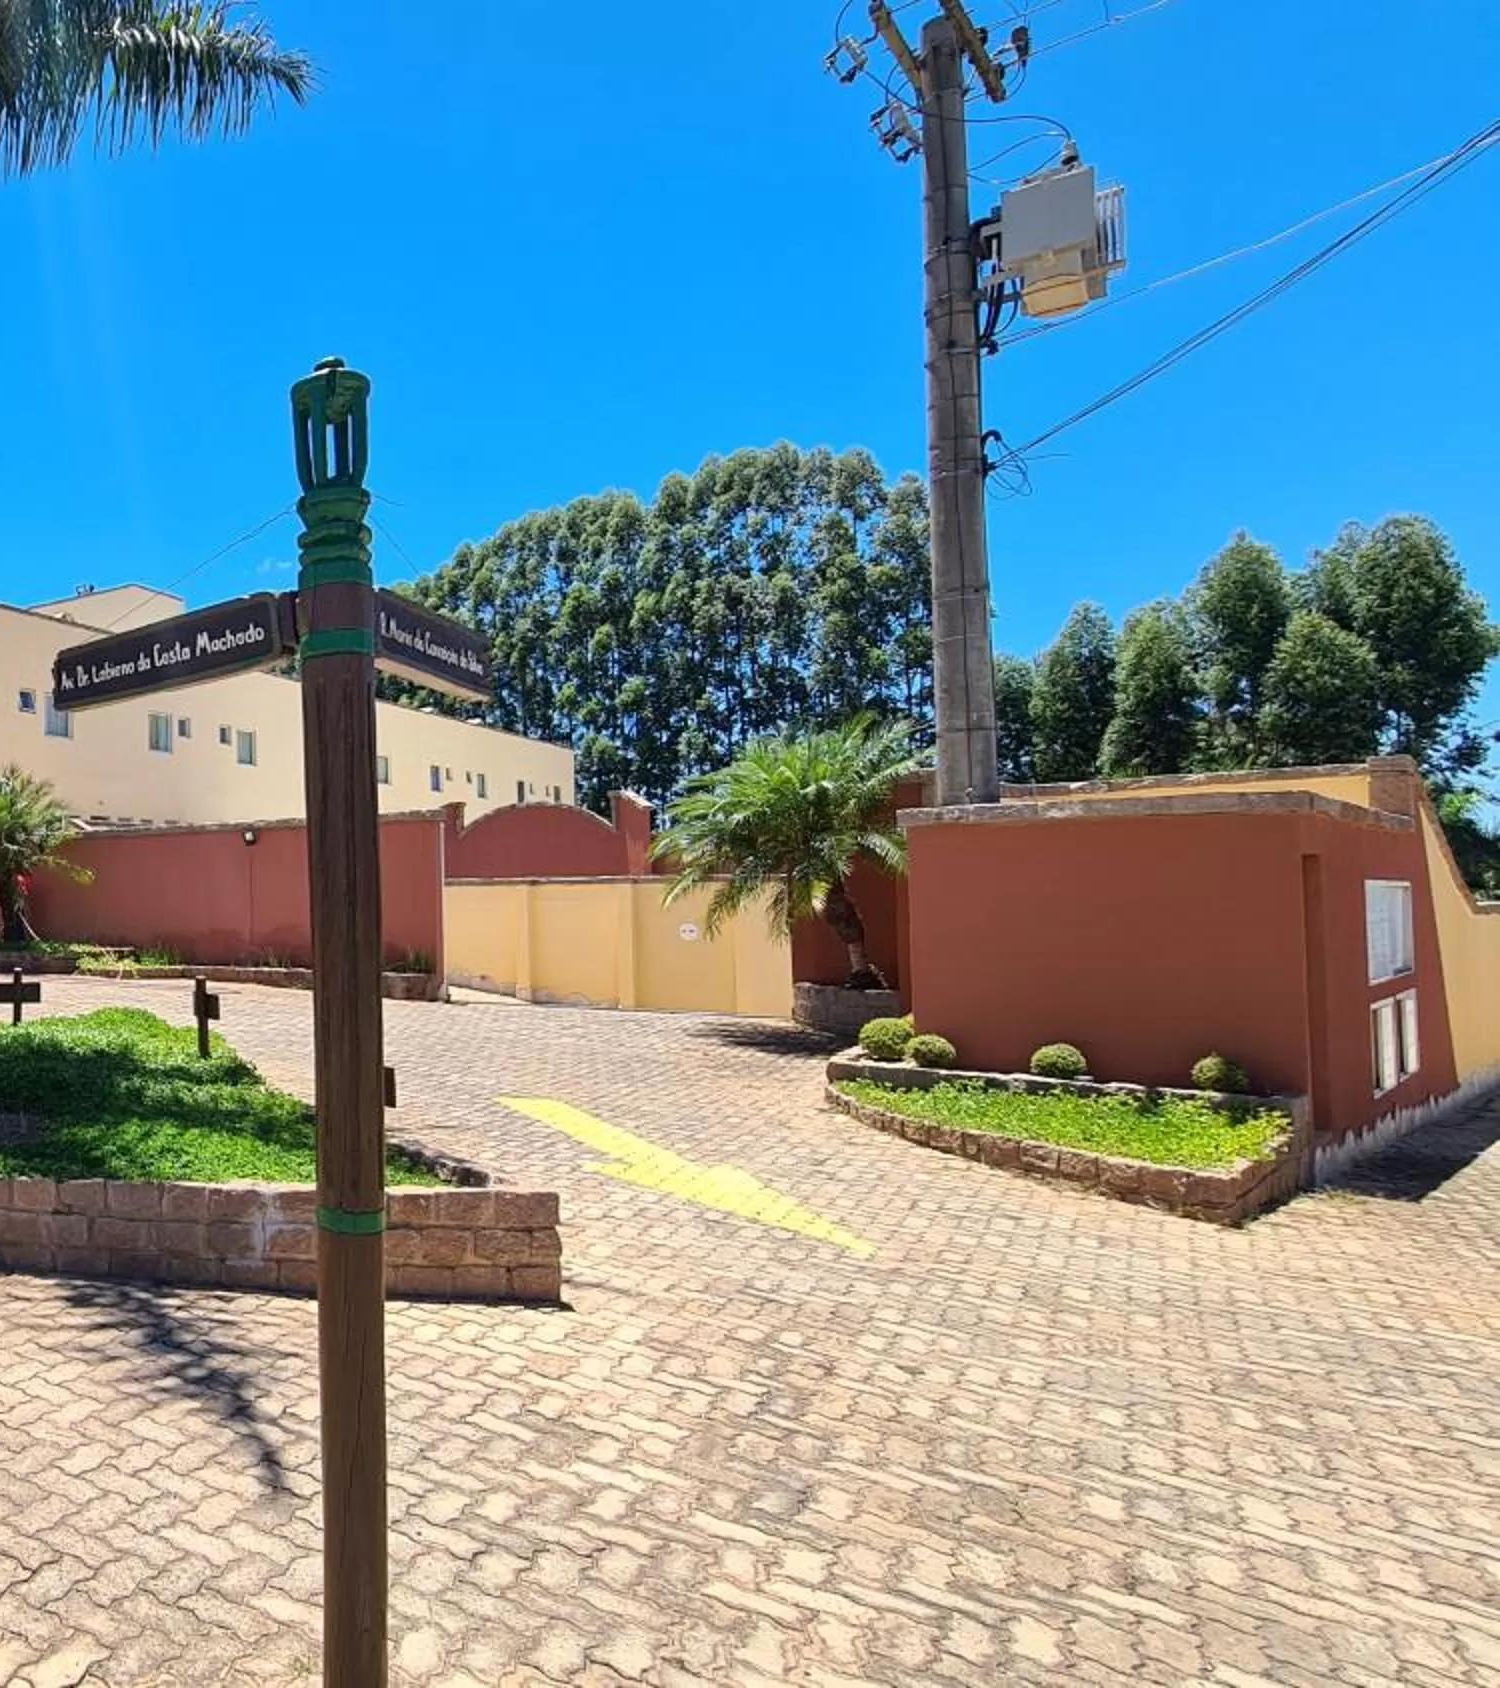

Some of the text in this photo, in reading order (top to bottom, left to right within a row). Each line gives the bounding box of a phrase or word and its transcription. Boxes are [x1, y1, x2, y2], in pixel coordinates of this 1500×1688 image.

[137, 652, 151, 671] da
[153, 642, 191, 667] Costa
[195, 623, 265, 657] Machado
